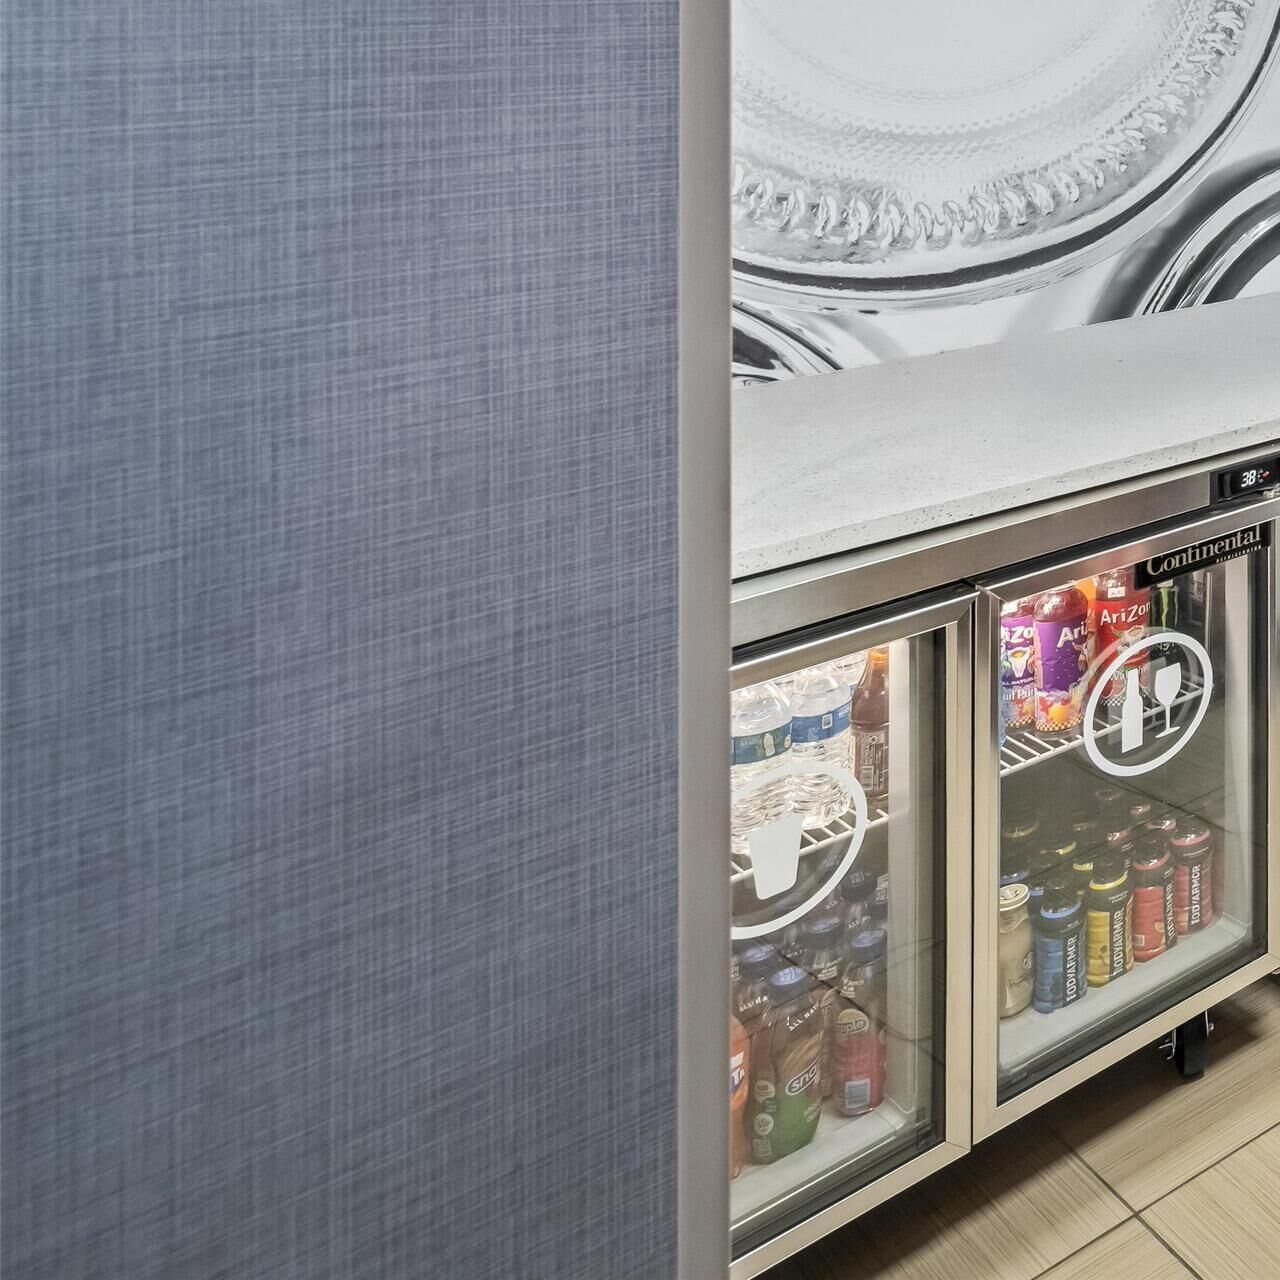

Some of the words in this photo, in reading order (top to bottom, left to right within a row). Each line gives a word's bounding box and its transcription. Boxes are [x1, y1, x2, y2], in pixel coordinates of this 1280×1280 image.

[1240, 469, 1257, 488] 38
[1146, 524, 1262, 576] Continental
[1099, 601, 1151, 627] AriZon
